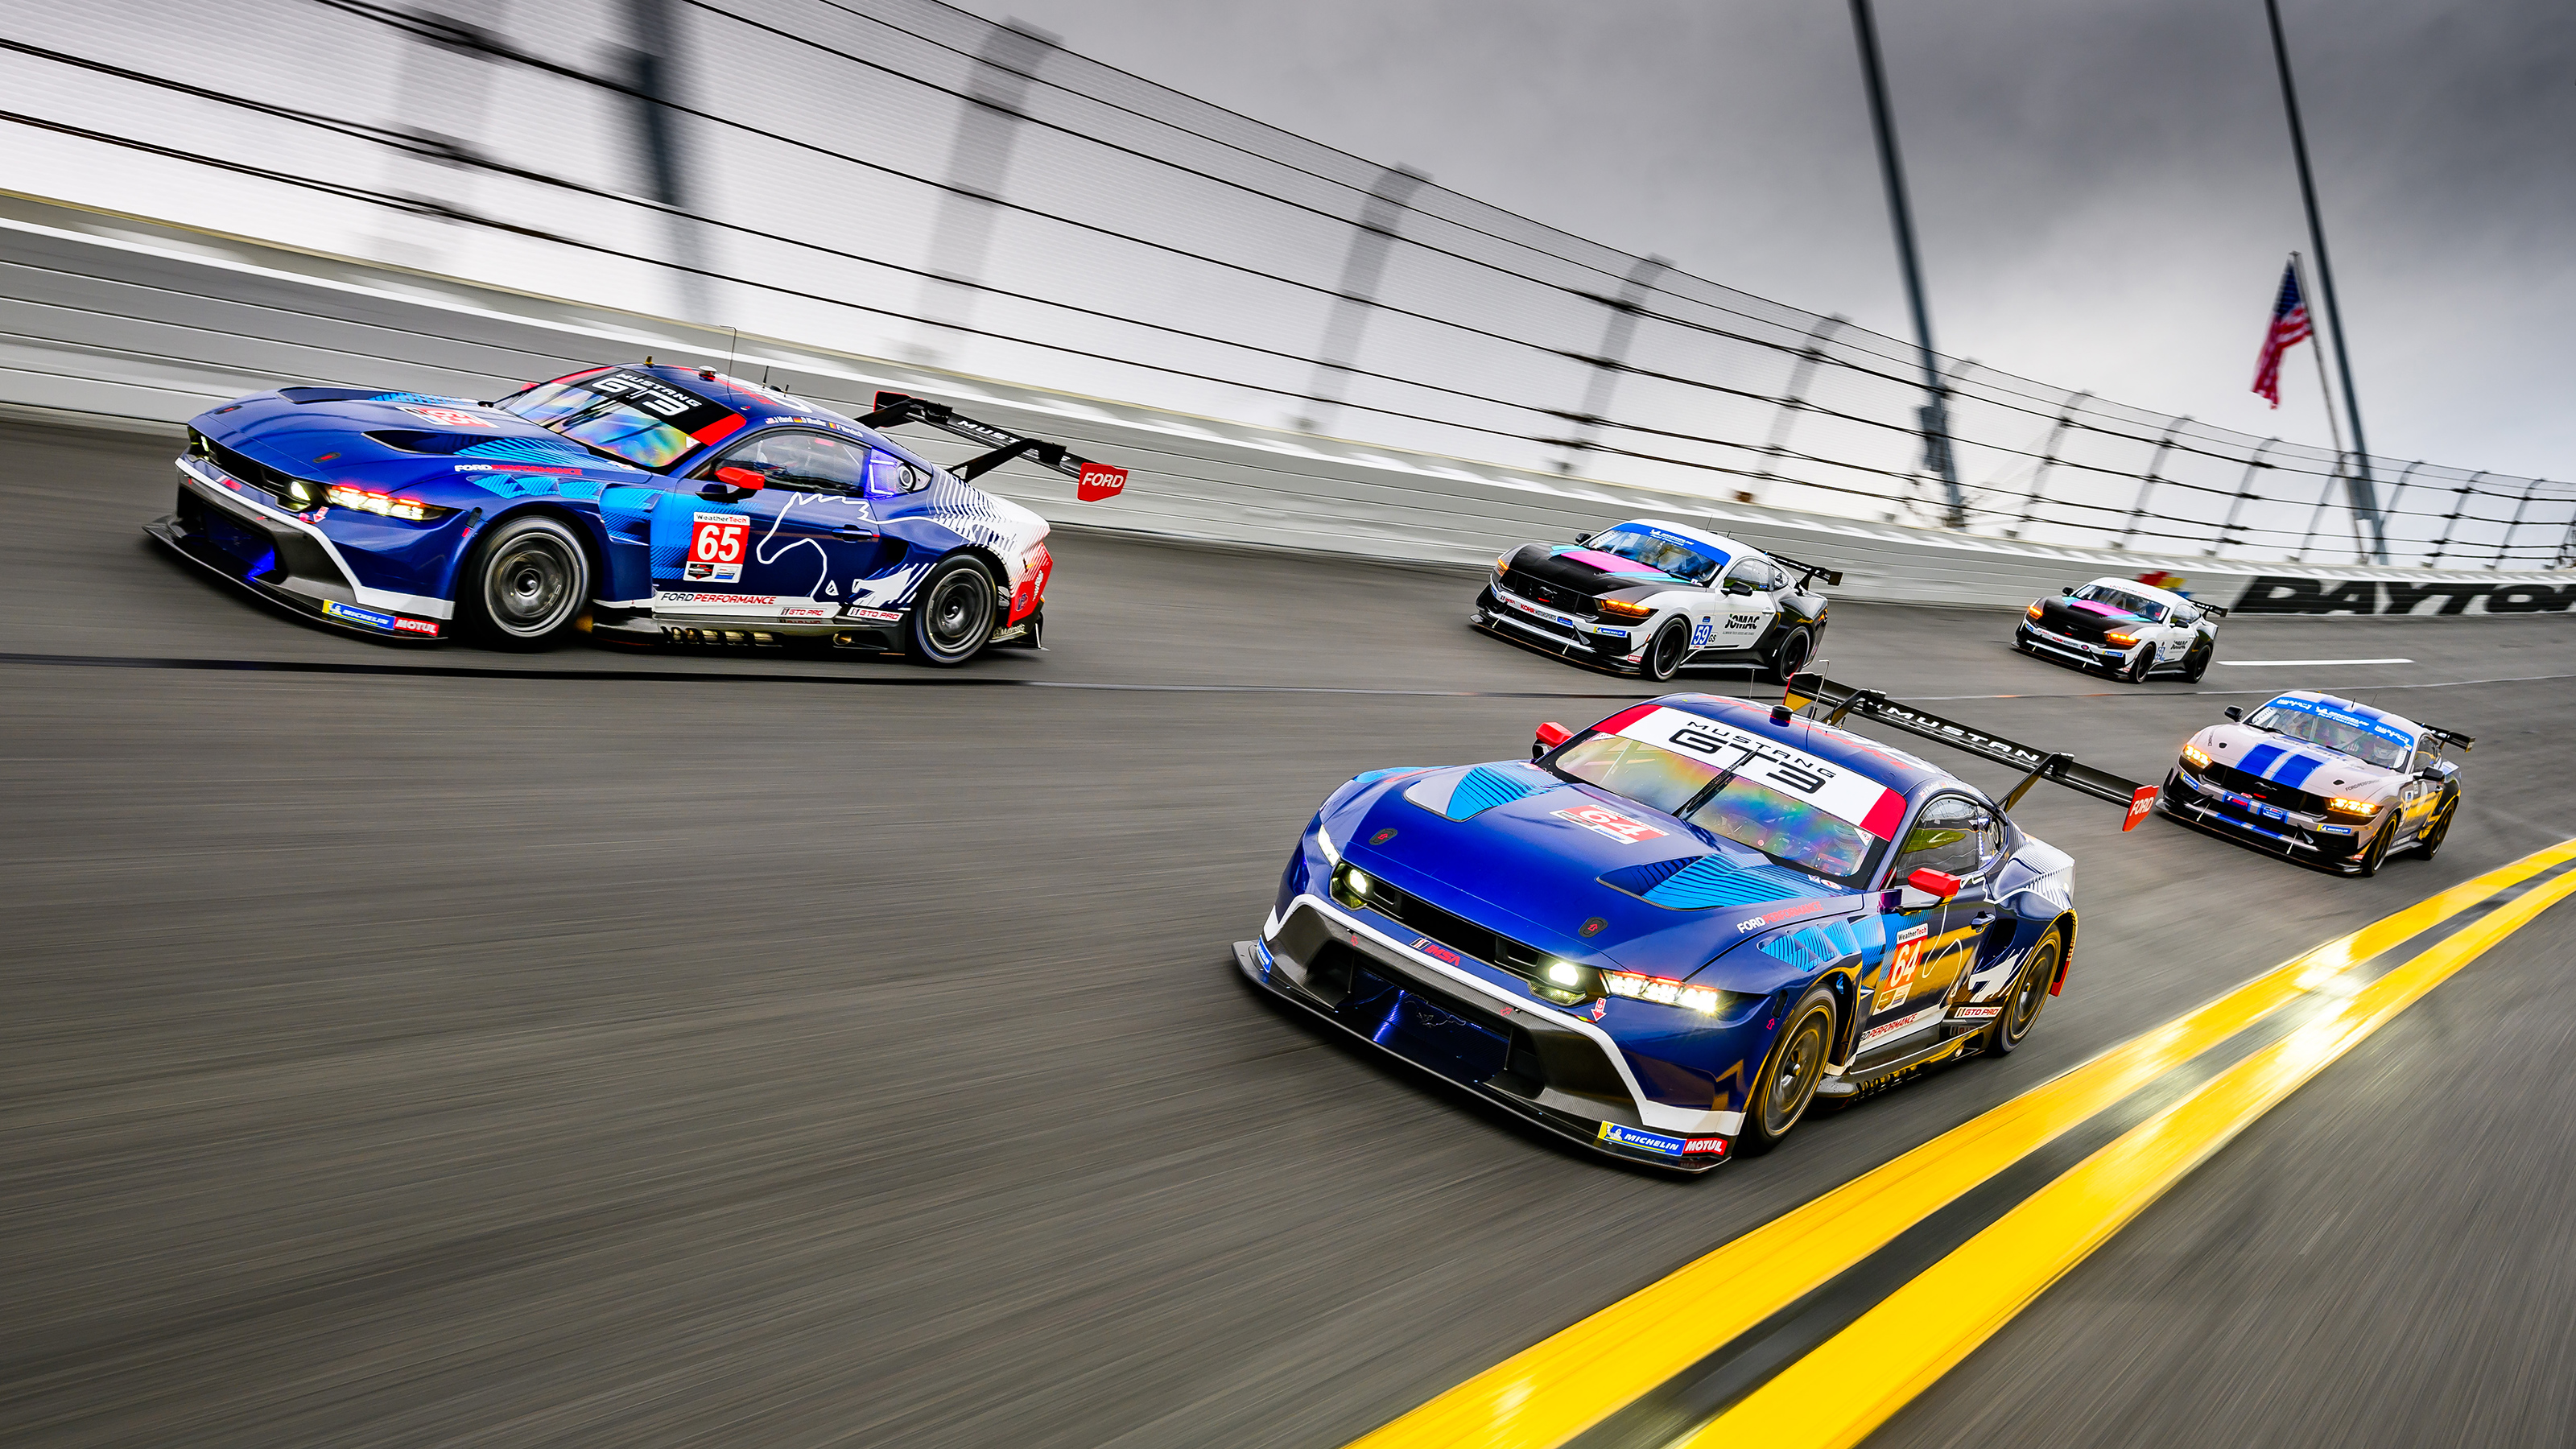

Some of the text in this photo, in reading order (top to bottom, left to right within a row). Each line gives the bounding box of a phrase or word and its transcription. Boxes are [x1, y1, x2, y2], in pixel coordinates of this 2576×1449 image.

[592, 377, 690, 416] GT3
[616, 373, 703, 407] MUSTANG
[1082, 473, 1125, 489] FORD
[696, 514, 748, 523] WeatherTech
[697, 525, 741, 562] 65
[342, 610, 390, 625] MICHELIN
[879, 612, 900, 620] PRO
[1520, 604, 1535, 614] KOHR
[395, 619, 436, 634] MOTUL
[1724, 613, 1761, 630] JOMAC
[1694, 625, 1710, 644] 59
[1707, 634, 1717, 642] GS
[1887, 706, 2040, 762] MUSTAN
[1686, 721, 1837, 778] MUSTANG
[1668, 729, 1826, 795] GT3
[2129, 796, 2154, 817] FORD
[1579, 810, 1649, 836] 64
[1898, 927, 1927, 941] WeatherTech
[1424, 943, 1462, 967] IMSA
[1890, 940, 1922, 988] 64
[1964, 1008, 2000, 1016] GTD PRO
[1624, 1133, 1679, 1151] MICHELIN
[1685, 1141, 1723, 1153] MOTUL
